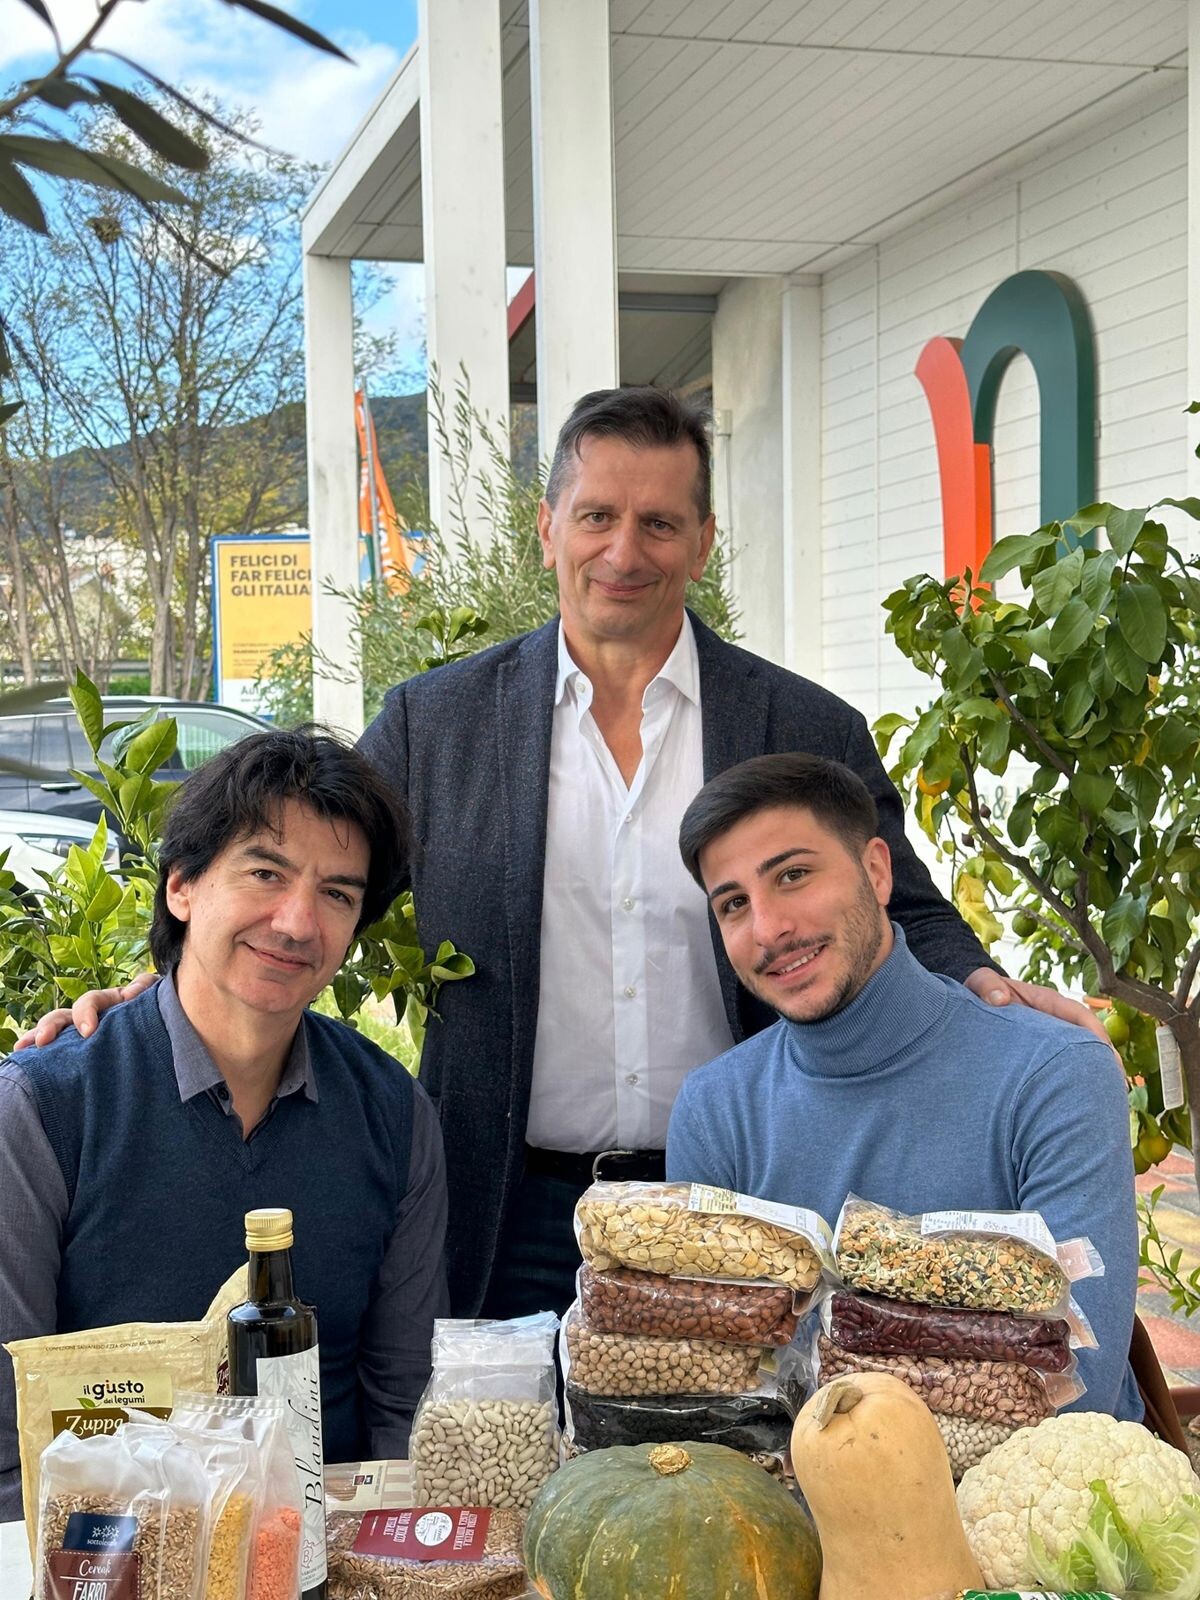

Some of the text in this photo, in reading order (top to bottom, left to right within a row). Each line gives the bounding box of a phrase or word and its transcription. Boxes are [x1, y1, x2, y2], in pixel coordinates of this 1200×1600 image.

[230, 554, 297, 567] FELICI DI
[231, 569, 312, 582] FAR FELICI
[231, 584, 311, 597] GLI ITALIA
[83, 1384, 91, 1395] il
[114, 1395, 145, 1405] legumi
[66, 1415, 123, 1437] Zuppa
[288, 1371, 323, 1509] Blandini
[72, 1581, 108, 1600] FARRO
